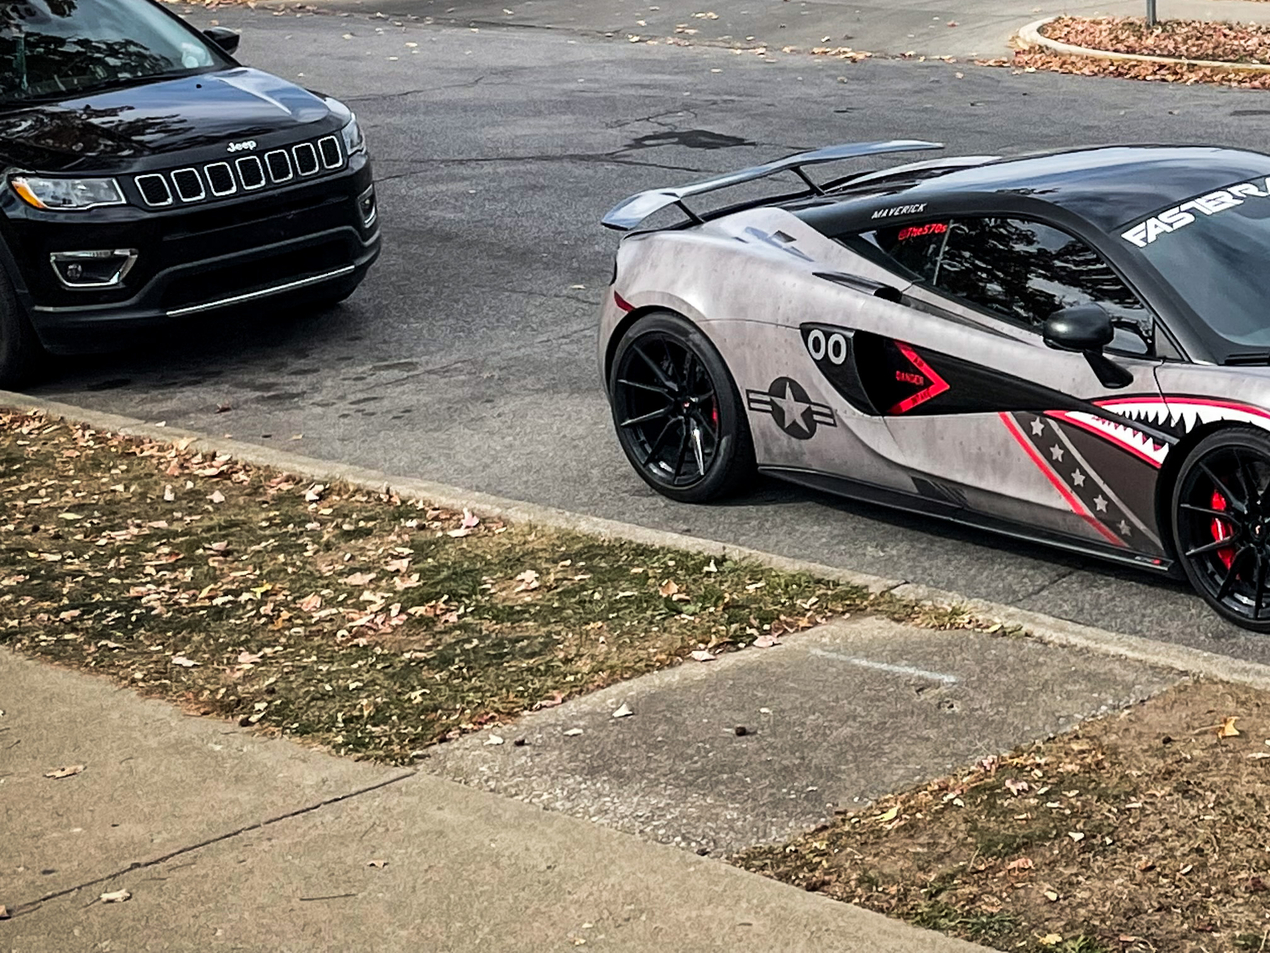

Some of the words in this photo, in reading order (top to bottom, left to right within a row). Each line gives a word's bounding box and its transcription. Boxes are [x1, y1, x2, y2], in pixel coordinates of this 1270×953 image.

[227, 141, 257, 153] Jeep
[871, 202, 928, 220] MAVERICK
[808, 329, 847, 365] 00
